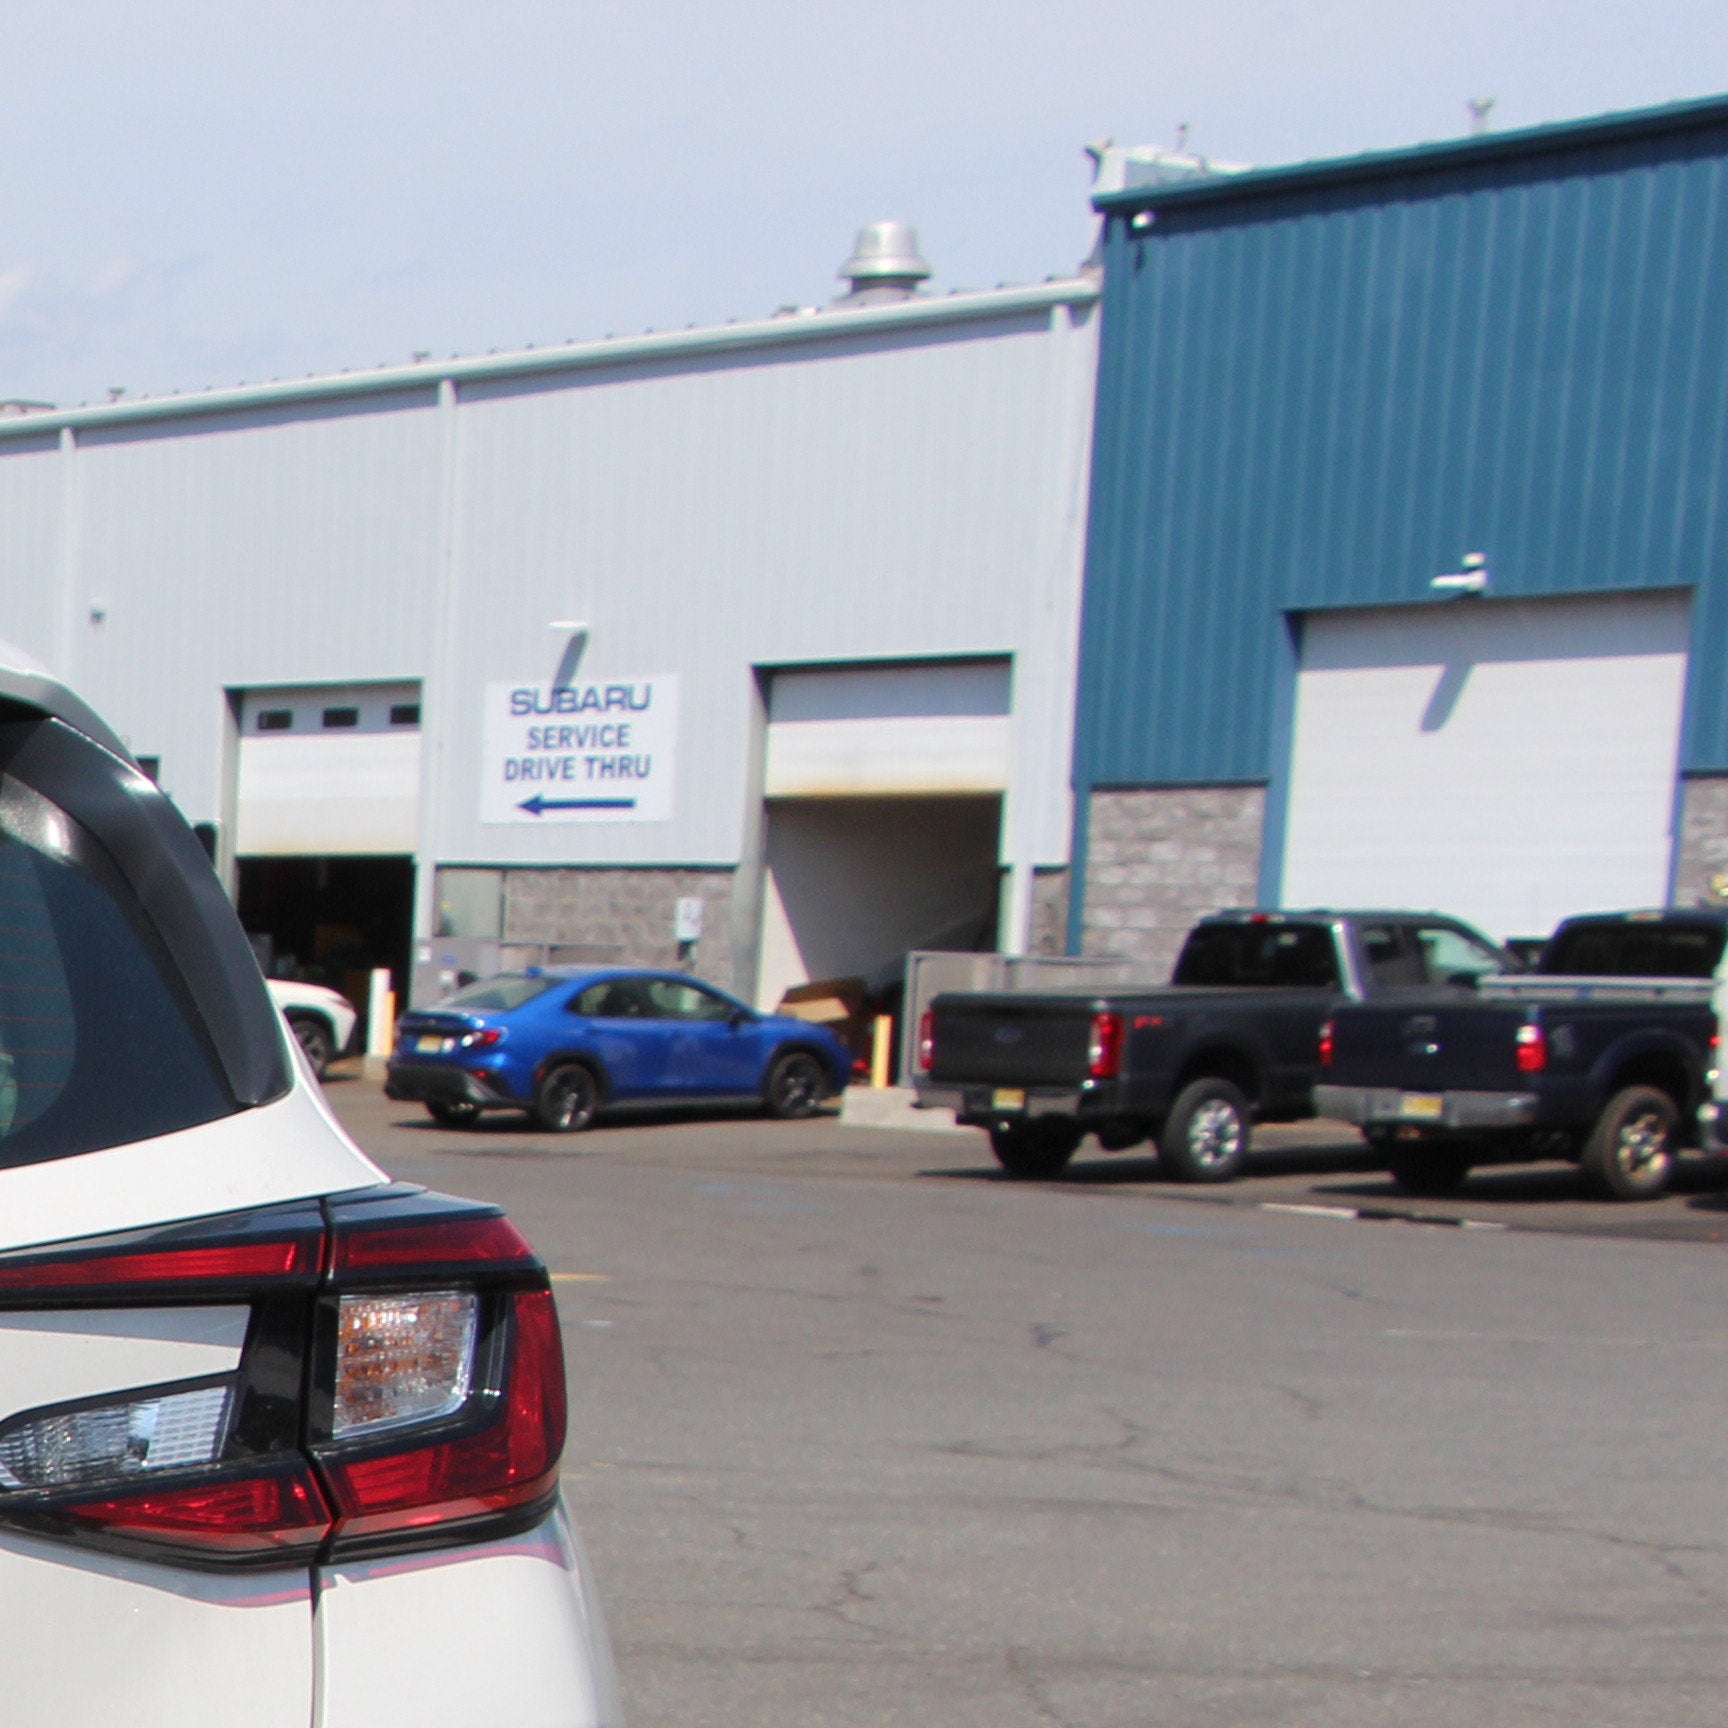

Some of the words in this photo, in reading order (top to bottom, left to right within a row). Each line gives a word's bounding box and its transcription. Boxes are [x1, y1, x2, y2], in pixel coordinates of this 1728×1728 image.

[510, 683, 652, 716] SUBARU
[527, 723, 631, 750] SERVICE
[504, 756, 575, 781] DRIVE
[584, 754, 651, 779] THRU
